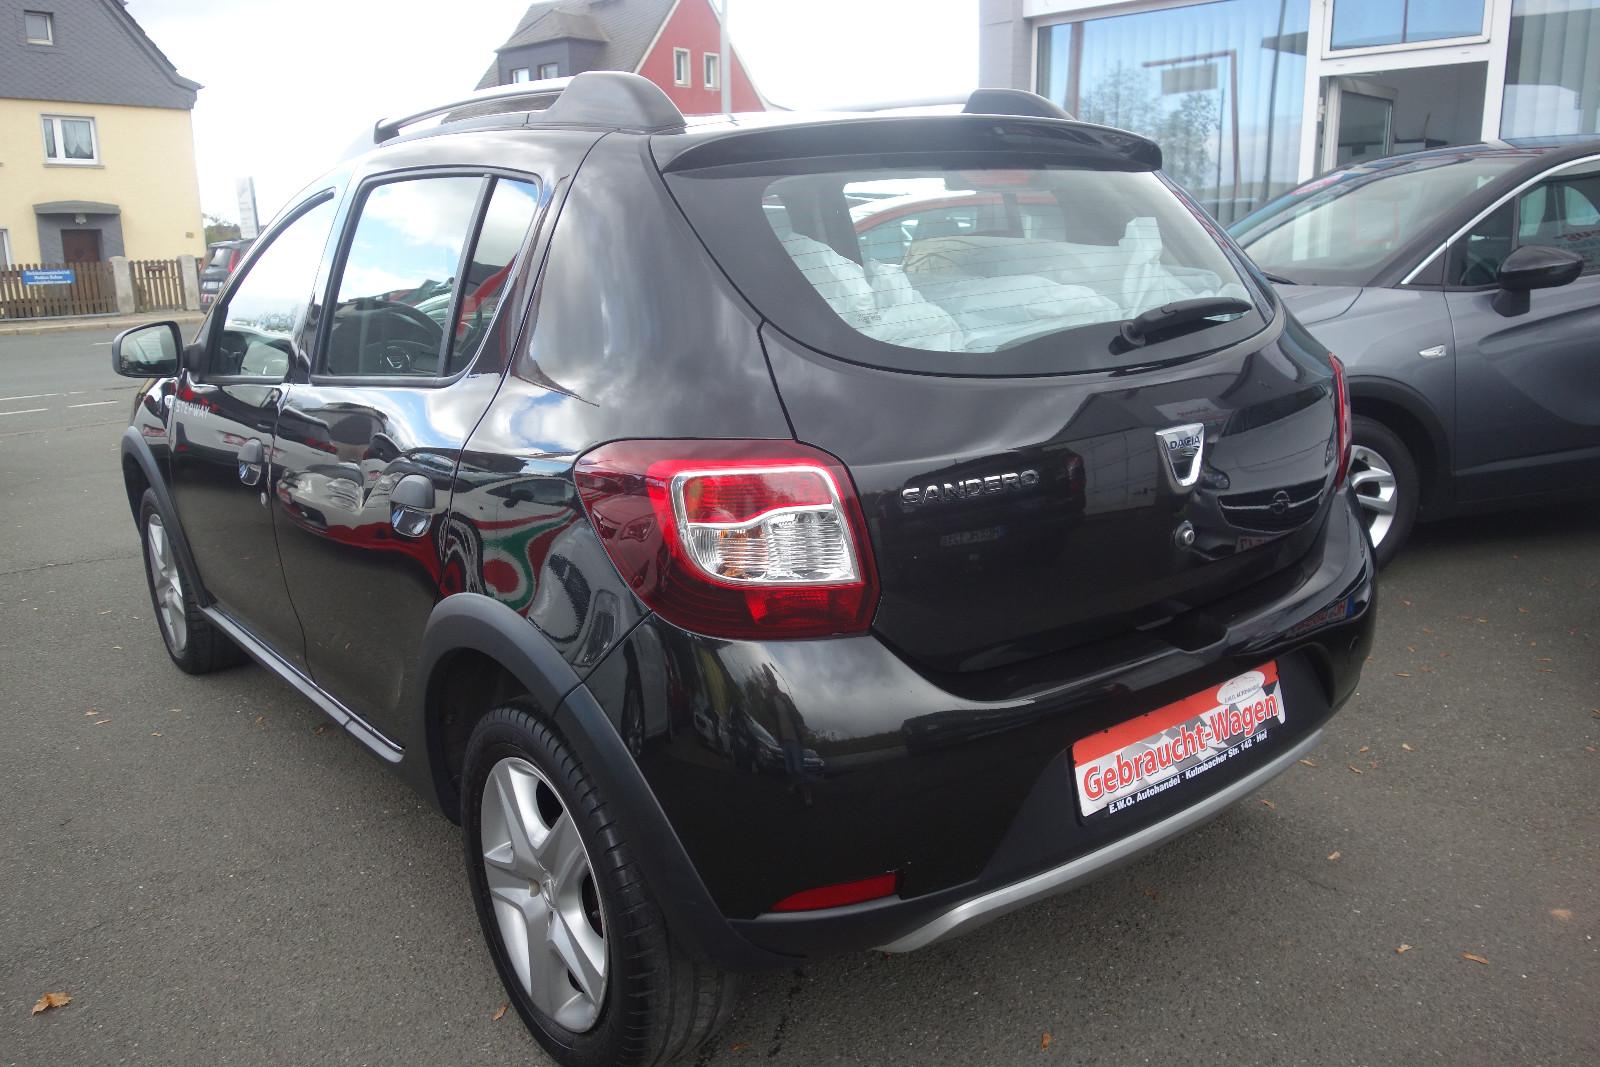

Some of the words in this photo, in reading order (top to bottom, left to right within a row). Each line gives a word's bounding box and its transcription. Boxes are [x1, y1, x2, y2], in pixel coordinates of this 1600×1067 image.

[1170, 436, 1200, 449] DACIA
[902, 469, 1039, 503] SANDERO
[1083, 693, 1279, 800] Gebraucht-Wagen
[1108, 796, 1135, 814] E.W.O.
[1136, 775, 1180, 802] Autohandel
[1185, 753, 1227, 779] Kulmbacher
[1240, 739, 1253, 751] 142
